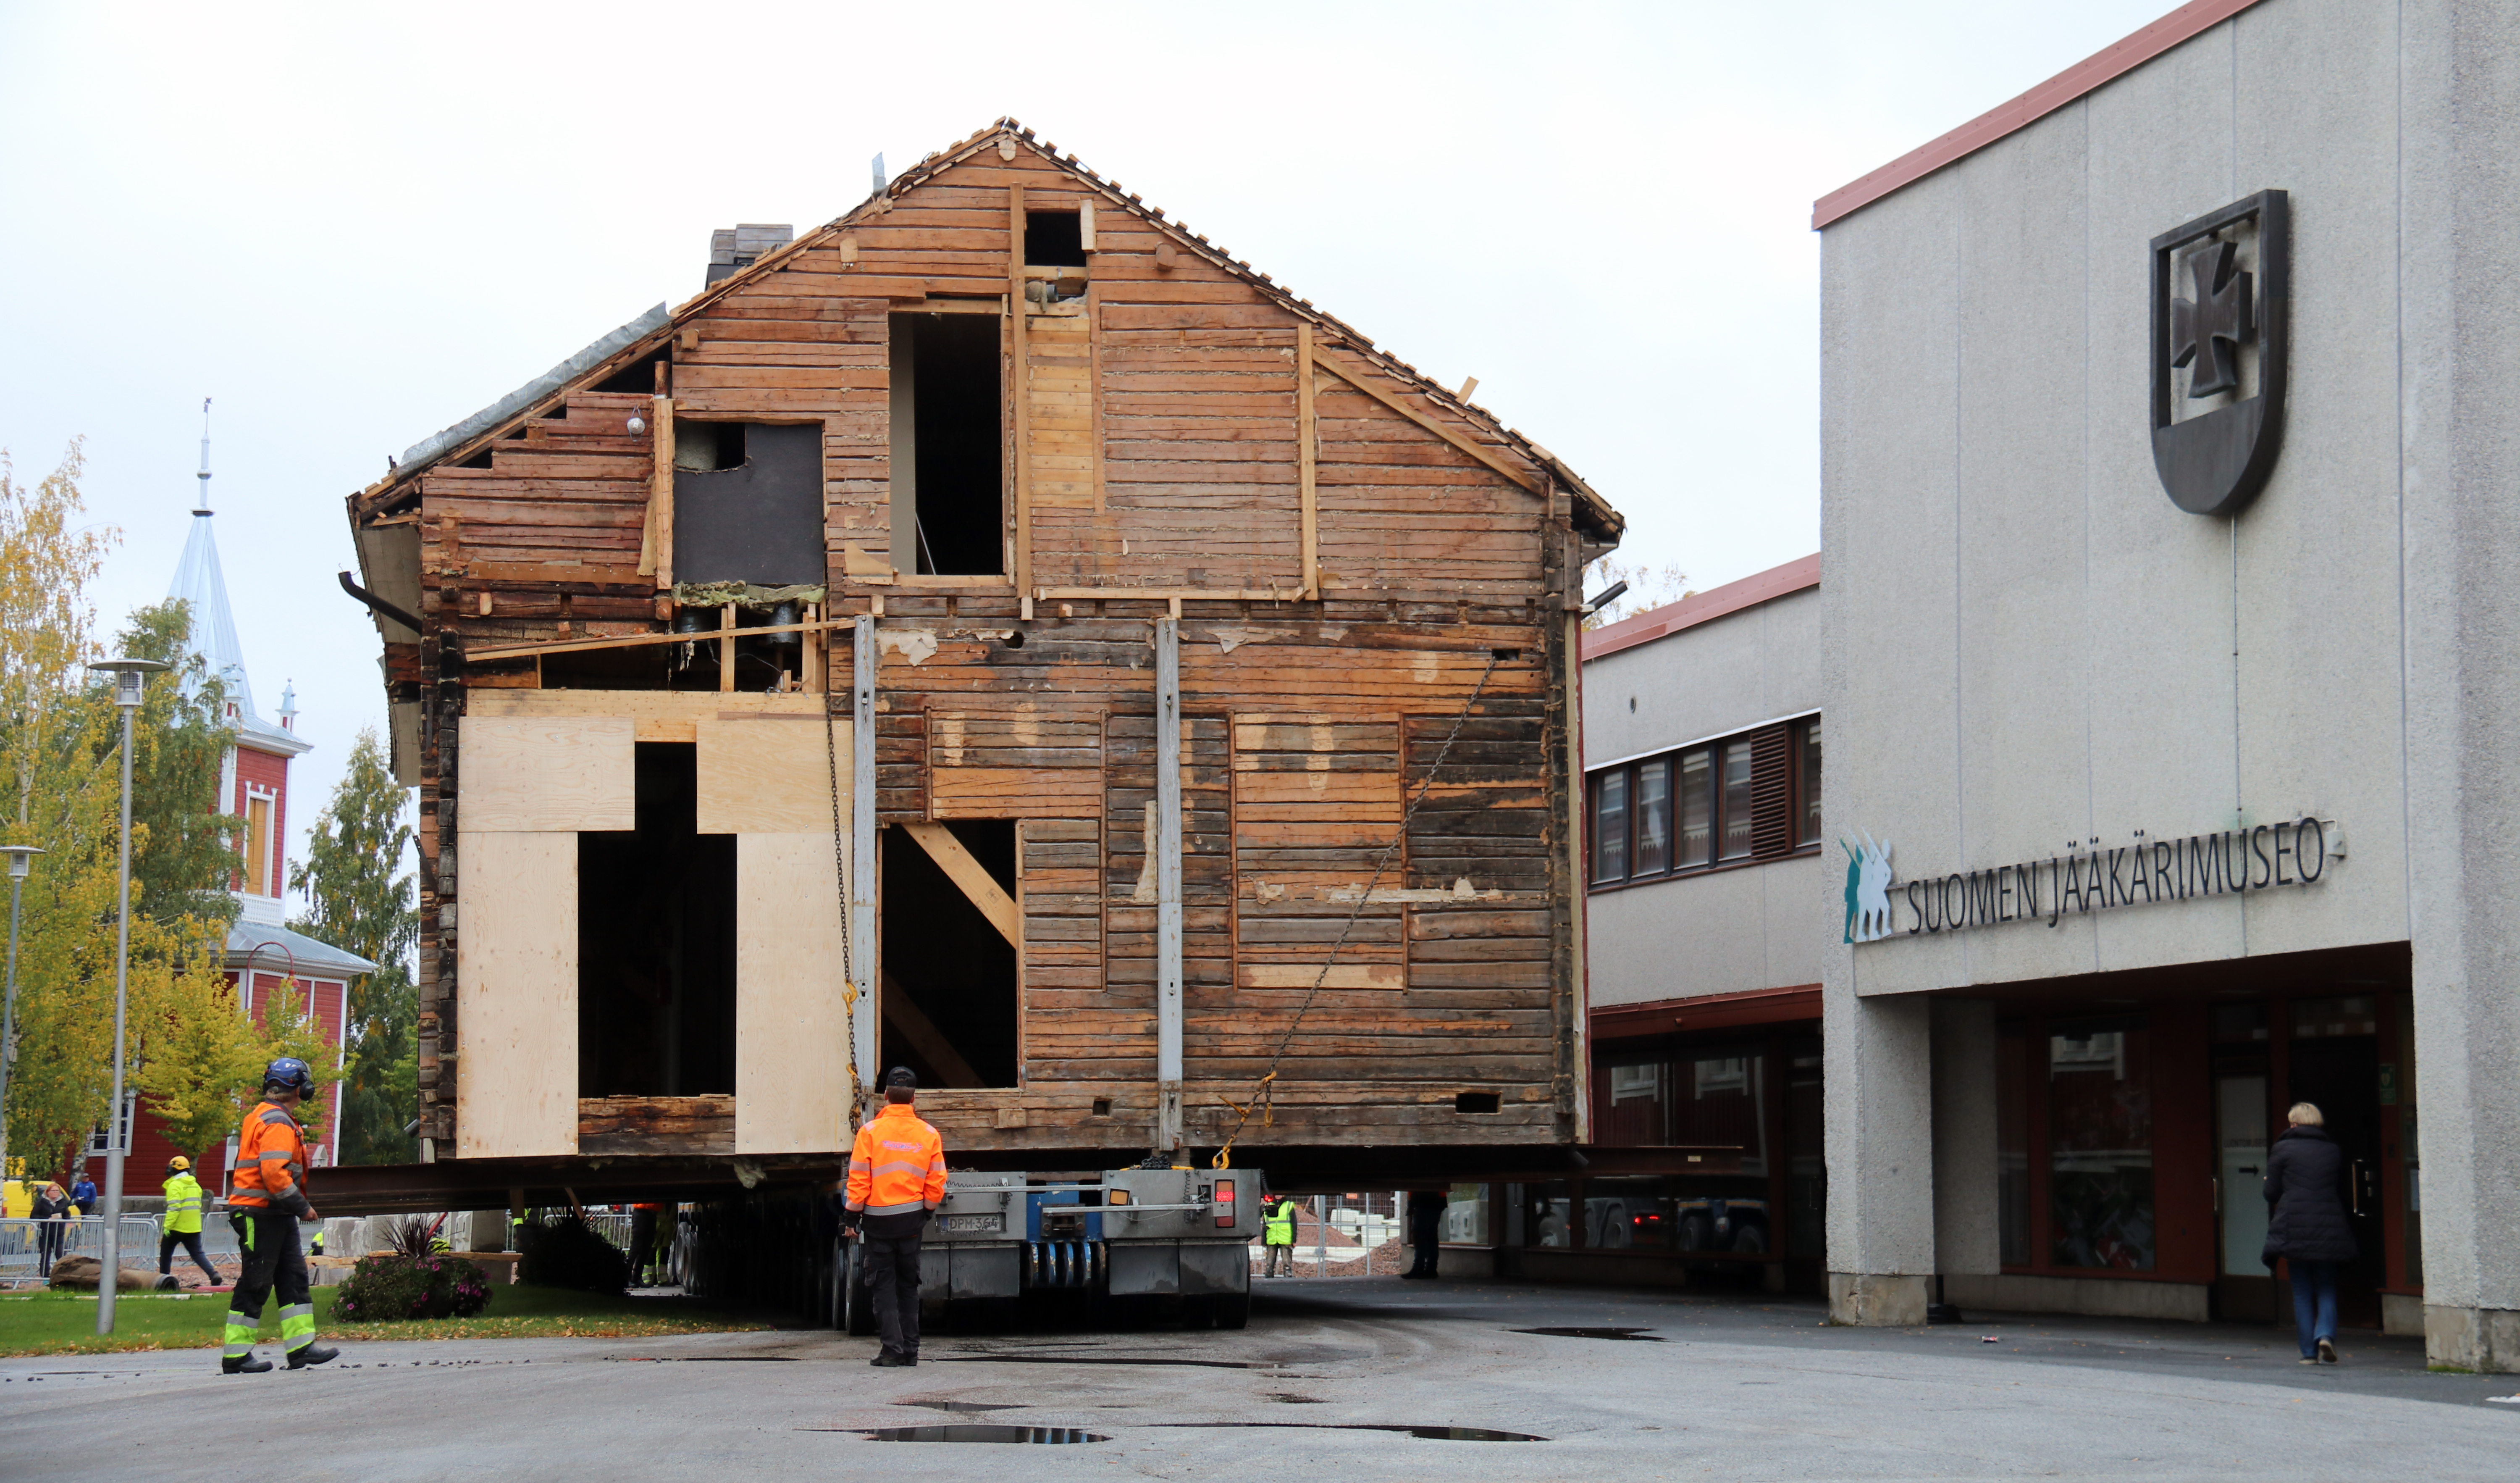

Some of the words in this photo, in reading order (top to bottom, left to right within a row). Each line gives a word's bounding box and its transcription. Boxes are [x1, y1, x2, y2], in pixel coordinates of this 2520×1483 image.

[1908, 862, 2037, 934] SUOMEN
[2048, 817, 2323, 928] JÄÄKÄRIMUSEO
[950, 1217, 998, 1229] DPM-364
